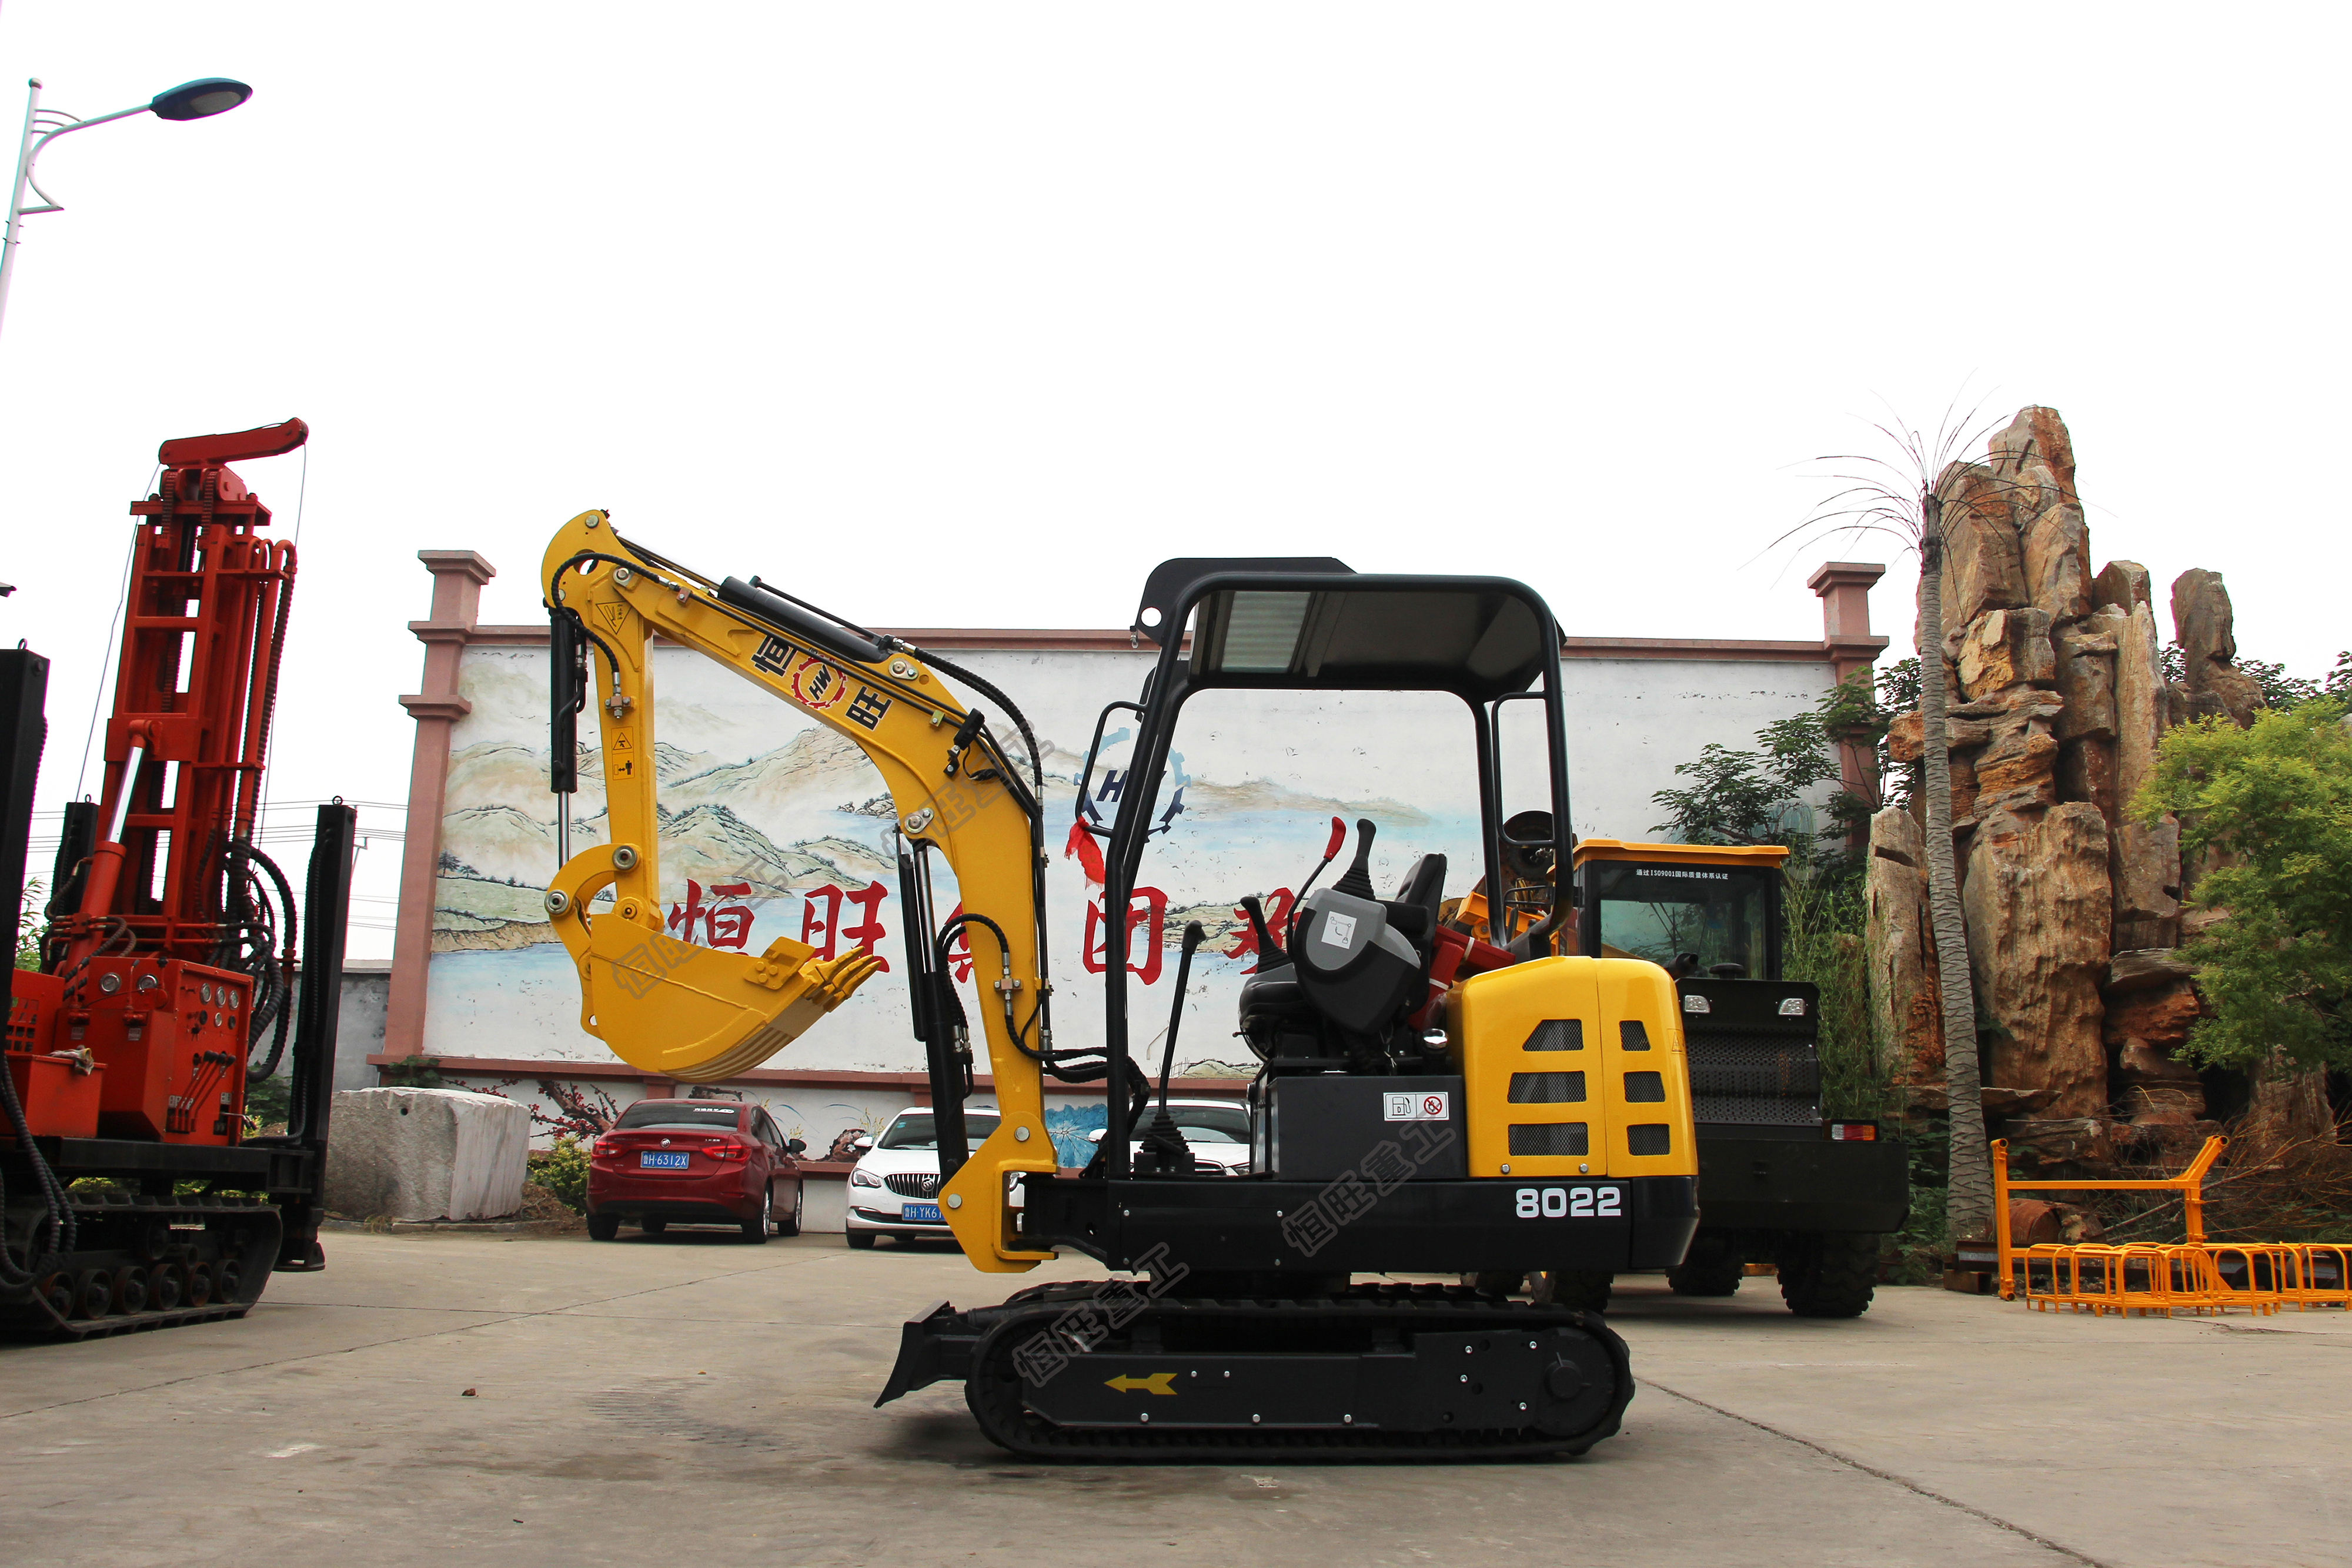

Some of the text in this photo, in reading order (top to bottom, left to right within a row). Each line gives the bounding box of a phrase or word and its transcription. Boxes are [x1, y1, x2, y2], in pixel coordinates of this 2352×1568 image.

[808, 664, 831, 701] HW
[846, 686, 893, 731] 旺
[1636, 869, 1729, 880] 通过ISO9001国际质量体系认证
[1516, 1187, 1621, 1218] 8022
